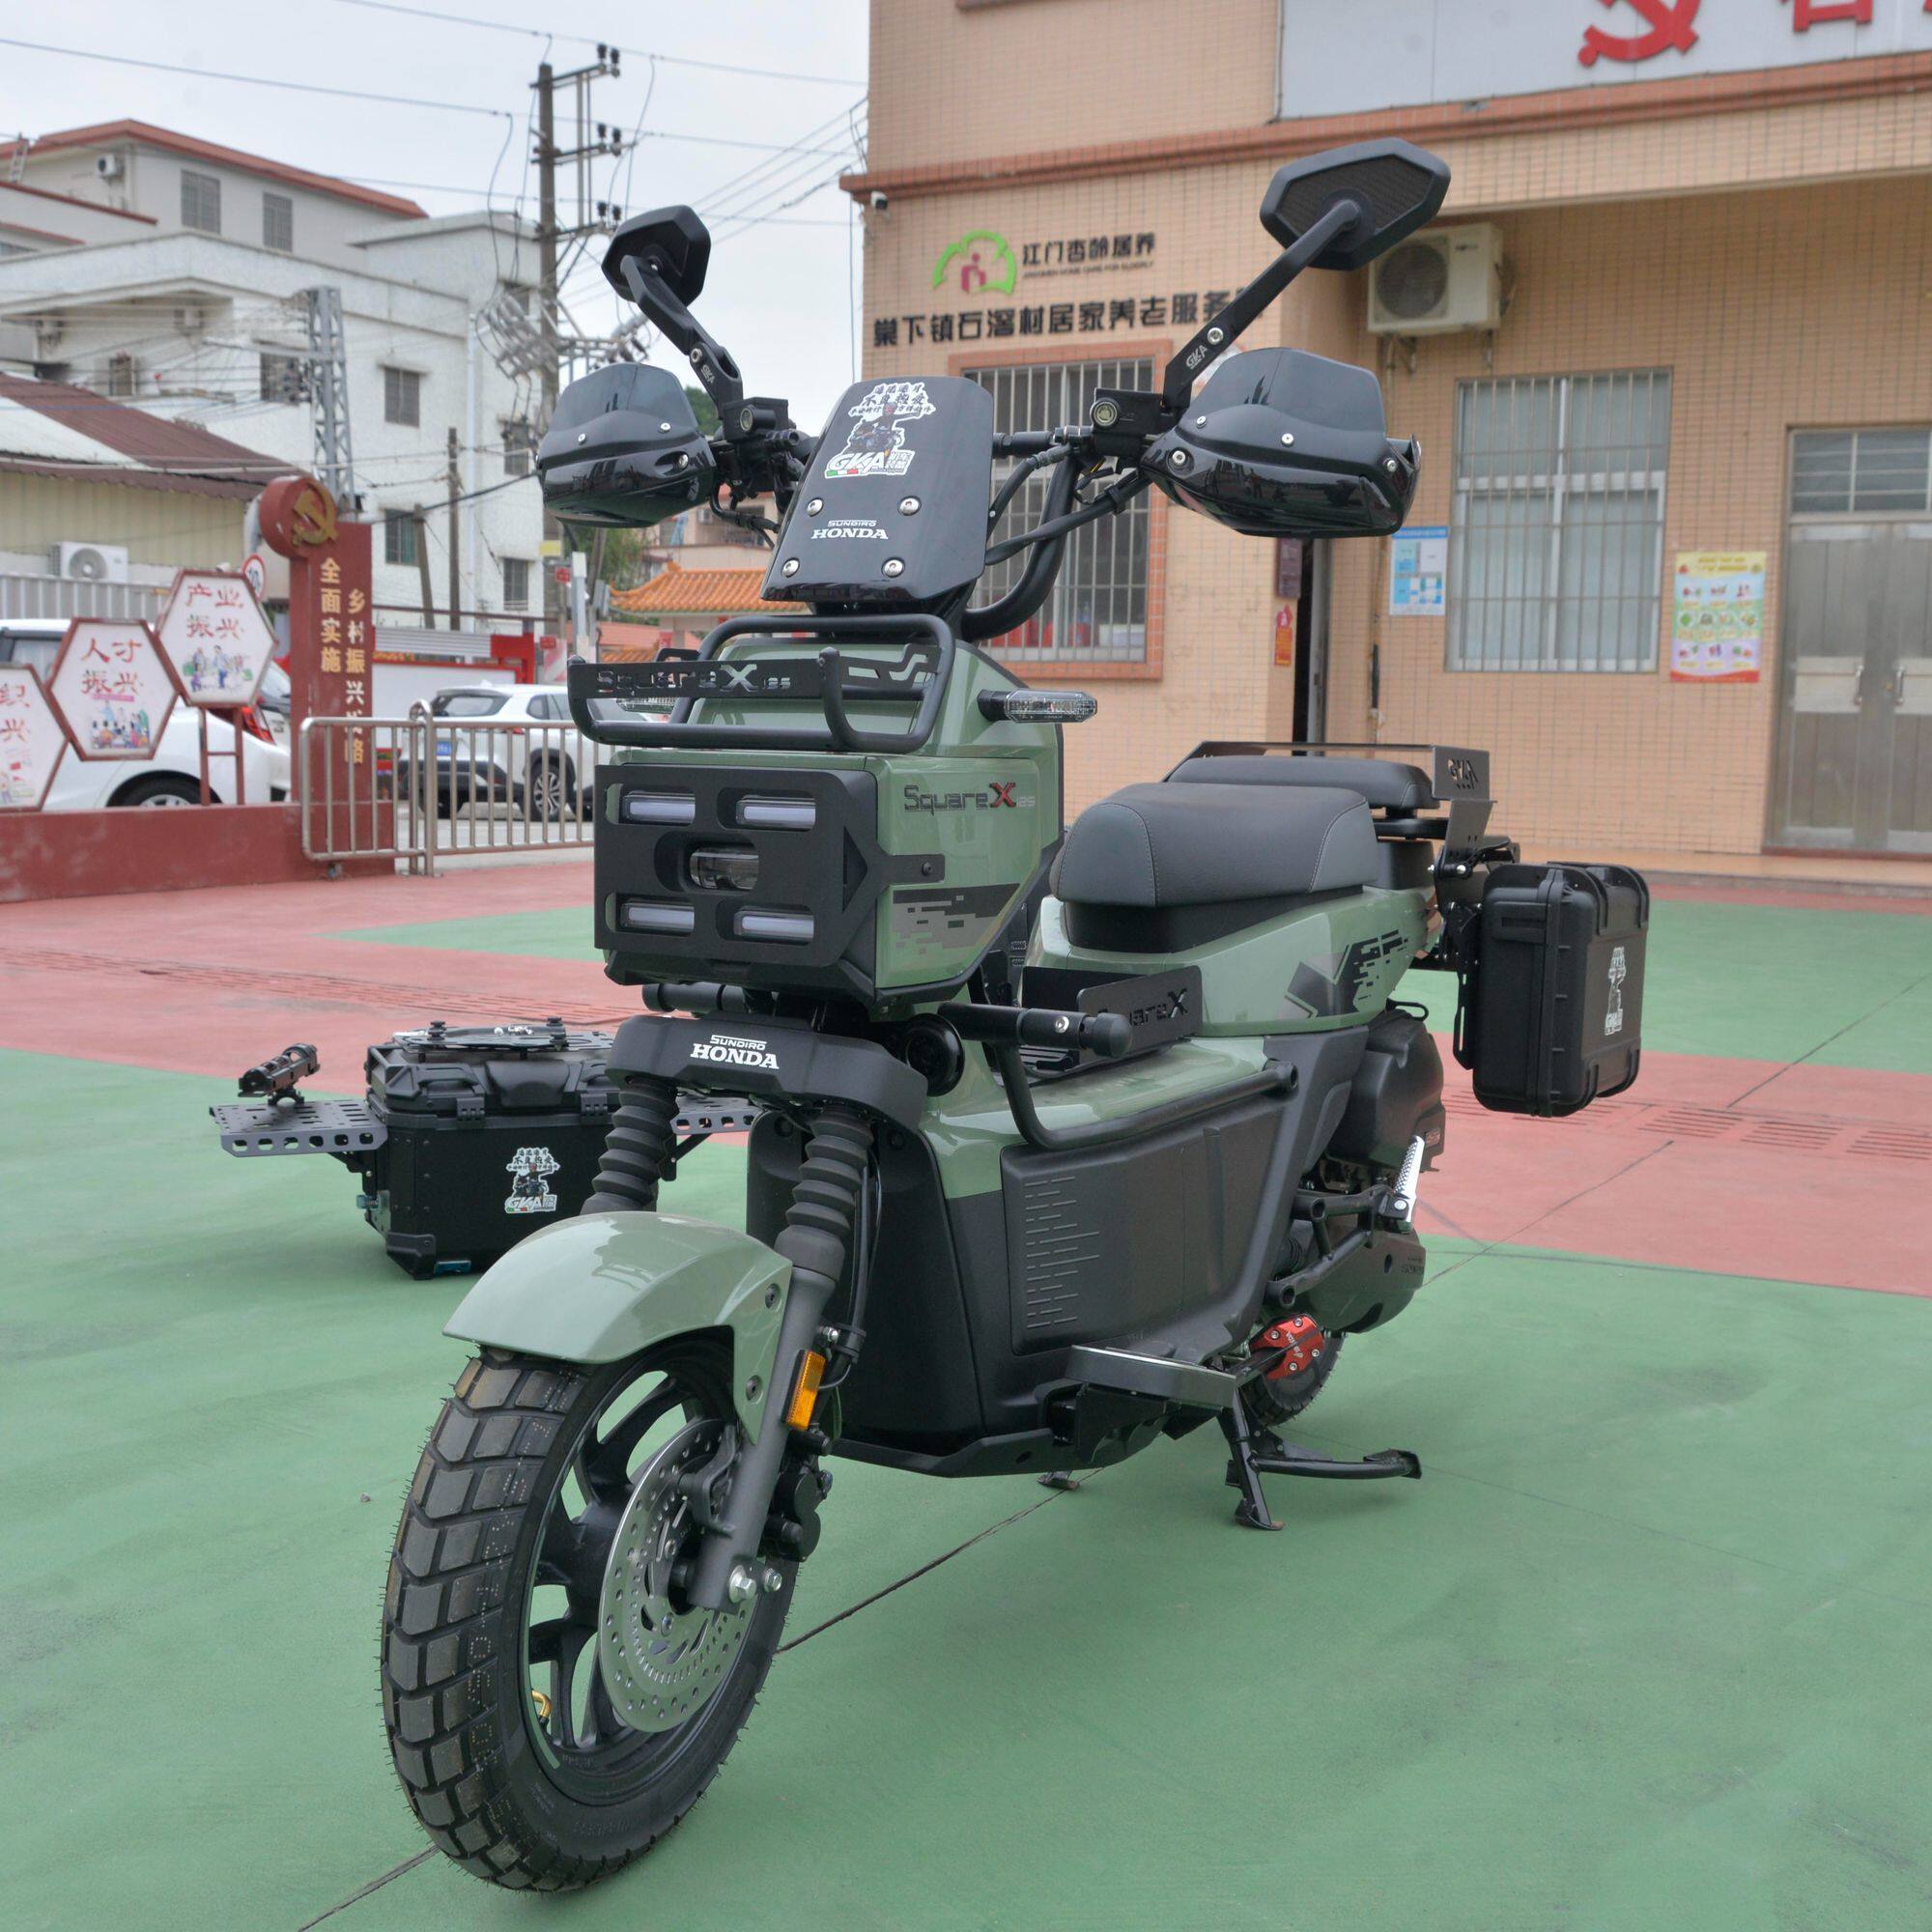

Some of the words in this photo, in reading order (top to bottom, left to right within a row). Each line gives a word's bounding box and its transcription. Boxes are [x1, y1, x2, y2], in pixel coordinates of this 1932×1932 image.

[828, 451, 885, 473] GKA
[810, 527, 889, 540] HONDA
[185, 582, 244, 609] 产业
[186, 614, 244, 639] 振兴
[320, 557, 342, 673] 全面实施
[81, 638, 143, 664] 人才
[81, 669, 144, 695] 振兴
[904, 781, 1016, 816] SquareX
[690, 1042, 780, 1069] HONDA
[709, 1035, 768, 1051] SUNDIRO
